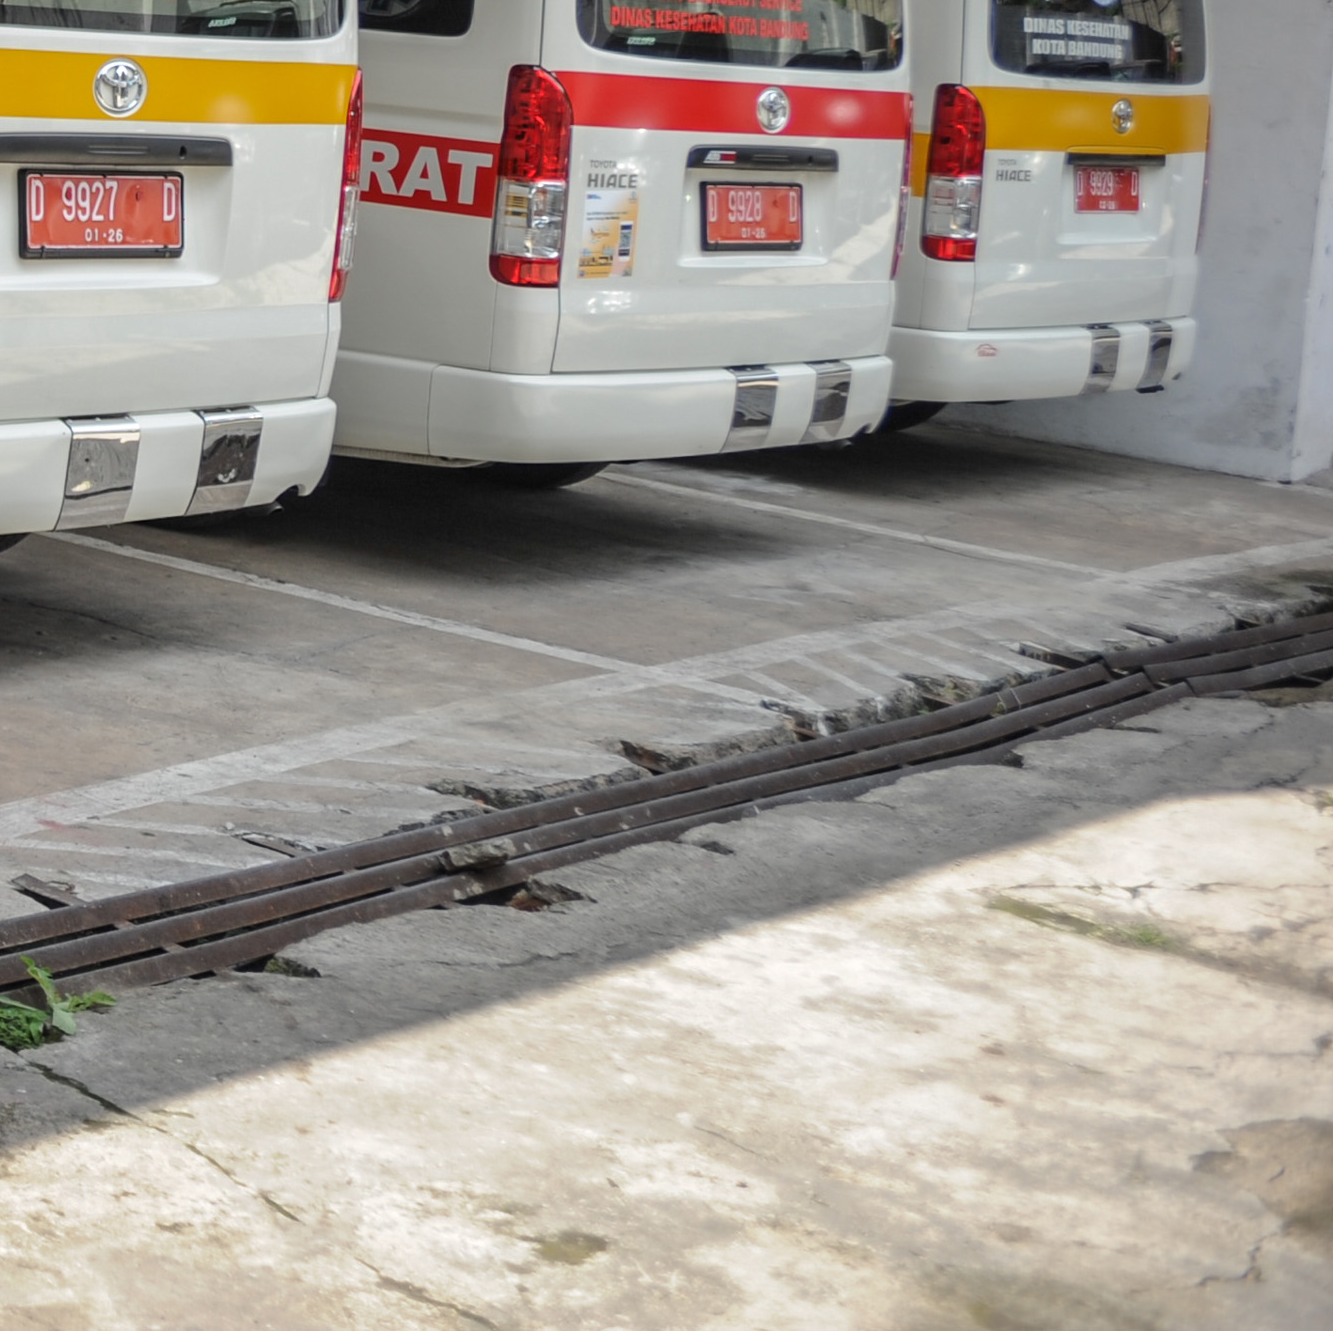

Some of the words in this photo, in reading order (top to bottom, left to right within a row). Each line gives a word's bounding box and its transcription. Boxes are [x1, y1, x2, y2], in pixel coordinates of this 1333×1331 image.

[610, 5, 653, 29] DINAS
[654, 9, 727, 34] KESEHATAN
[728, 15, 758, 37] KOTA
[759, 19, 810, 42] BANDUNG
[1023, 16, 1065, 35] DINAS
[1066, 19, 1130, 40] KESEHATAN
[1032, 38, 1066, 55] KOTA
[1067, 40, 1123, 59] BANDUNG
[590, 159, 618, 169] TOYOTA
[995, 169, 1032, 182] HIACE
[586, 172, 639, 189] HIACE
[1089, 171, 1114, 196] 9929
[30, 179, 45, 222] D
[61, 180, 119, 222] 9927
[162, 180, 177, 222] D
[708, 189, 718, 223] D
[727, 190, 763, 223] 9928
[789, 191, 798, 223] D
